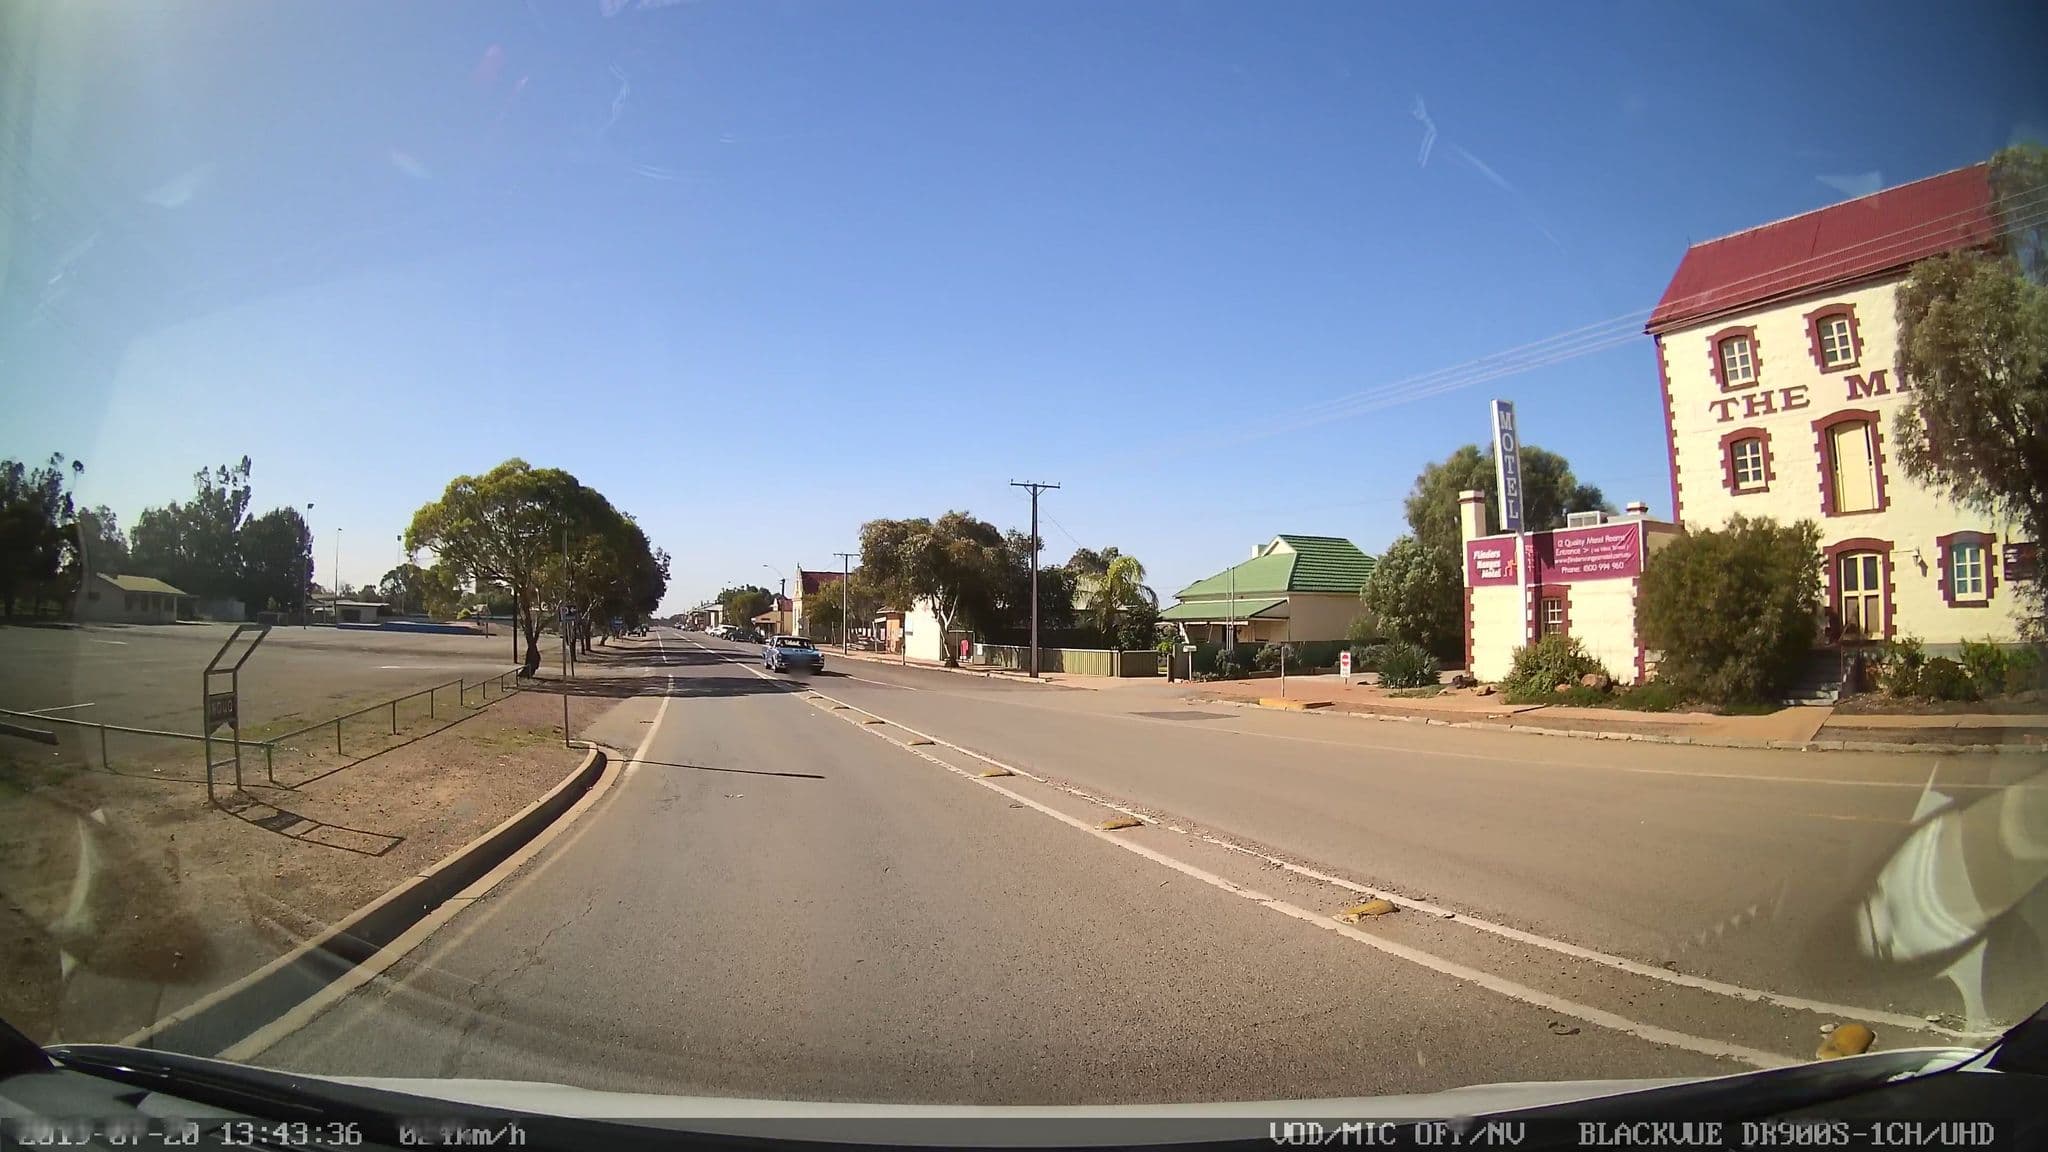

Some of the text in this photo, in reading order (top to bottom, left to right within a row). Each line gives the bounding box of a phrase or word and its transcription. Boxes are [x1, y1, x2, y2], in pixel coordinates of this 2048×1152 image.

[1708, 384, 1811, 422] THE
[1499, 411, 1519, 519] MOTEL
[1564, 537, 1585, 547] Quality
[1473, 549, 1501, 560] Flinders
[1555, 547, 1581, 556] Entrance
